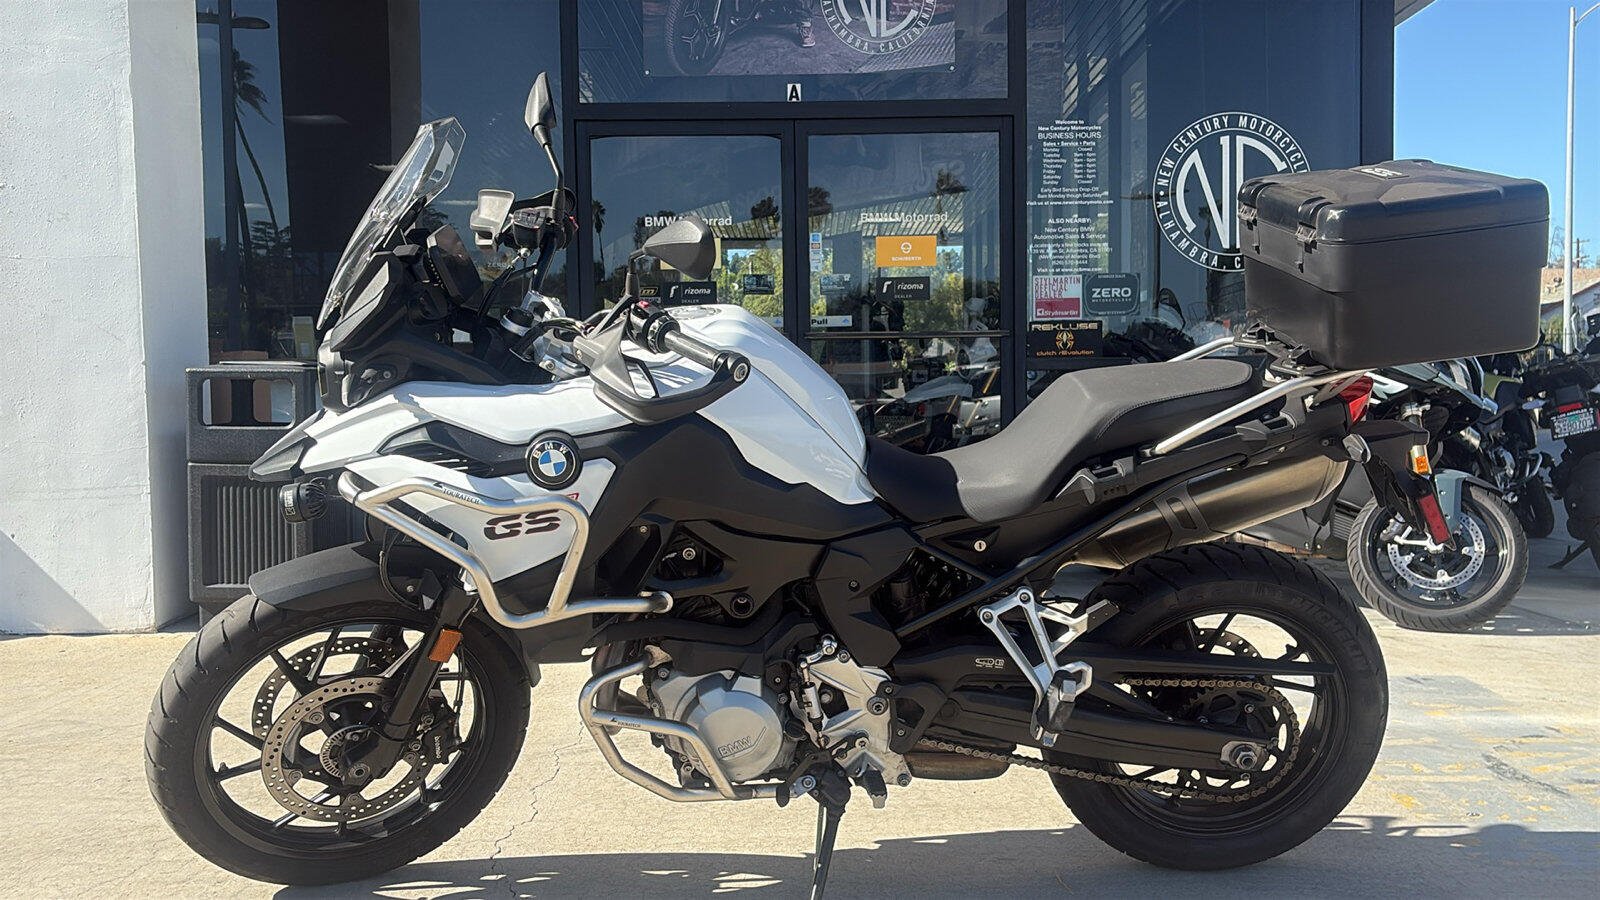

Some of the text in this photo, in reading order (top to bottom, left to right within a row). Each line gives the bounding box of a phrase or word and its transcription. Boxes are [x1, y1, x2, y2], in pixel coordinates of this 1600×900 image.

[788, 84, 800, 101] A
[1157, 116, 1308, 186] NEW CENTURY MOTORCYCL
[894, 212, 948, 222] Motorrad
[1092, 287, 1132, 298] ZERO
[1031, 323, 1098, 331] REKLUSE
[532, 442, 568, 458] BMW
[442, 488, 480, 504] TOURATECH
[484, 509, 561, 540] GS
[718, 736, 752, 758] BMW
